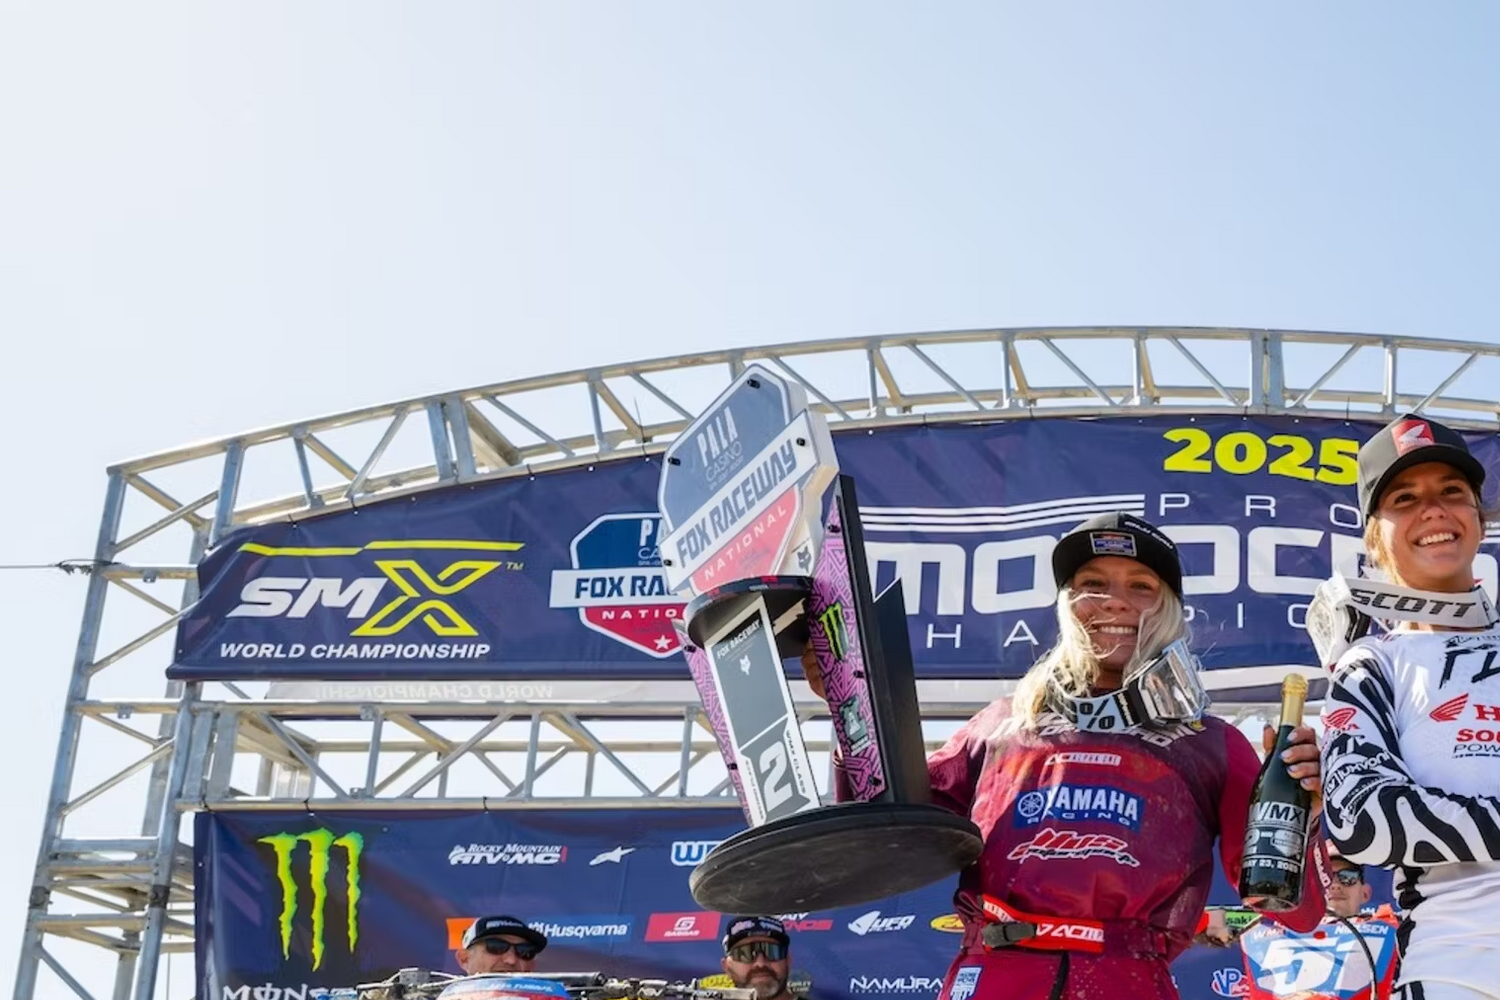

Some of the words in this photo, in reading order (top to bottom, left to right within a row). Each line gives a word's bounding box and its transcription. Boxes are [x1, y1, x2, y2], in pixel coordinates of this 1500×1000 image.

[697, 406, 739, 467] PALA
[705, 440, 743, 482] CASINO
[1163, 428, 1360, 485] 2025
[676, 517, 712, 569] FOX
[709, 438, 798, 540] RACEWAY
[704, 504, 788, 581] NATIONAL
[226, 560, 502, 637] SMX
[575, 576, 625, 599] FOX
[1350, 588, 1477, 619] SCOTT
[602, 608, 678, 620] NATIO
[219, 643, 305, 660] WORLD
[310, 643, 491, 660] CHAMPIONSHIP
[716, 644, 730, 660] FOX
[759, 741, 793, 813] 2
[1046, 785, 1138, 821] YAMAHA
[467, 844, 503, 853] ROCKY
[503, 844, 561, 853] MOUNTAIN
[543, 921, 628, 939] Husqvarna
[1257, 937, 1386, 997] 51
